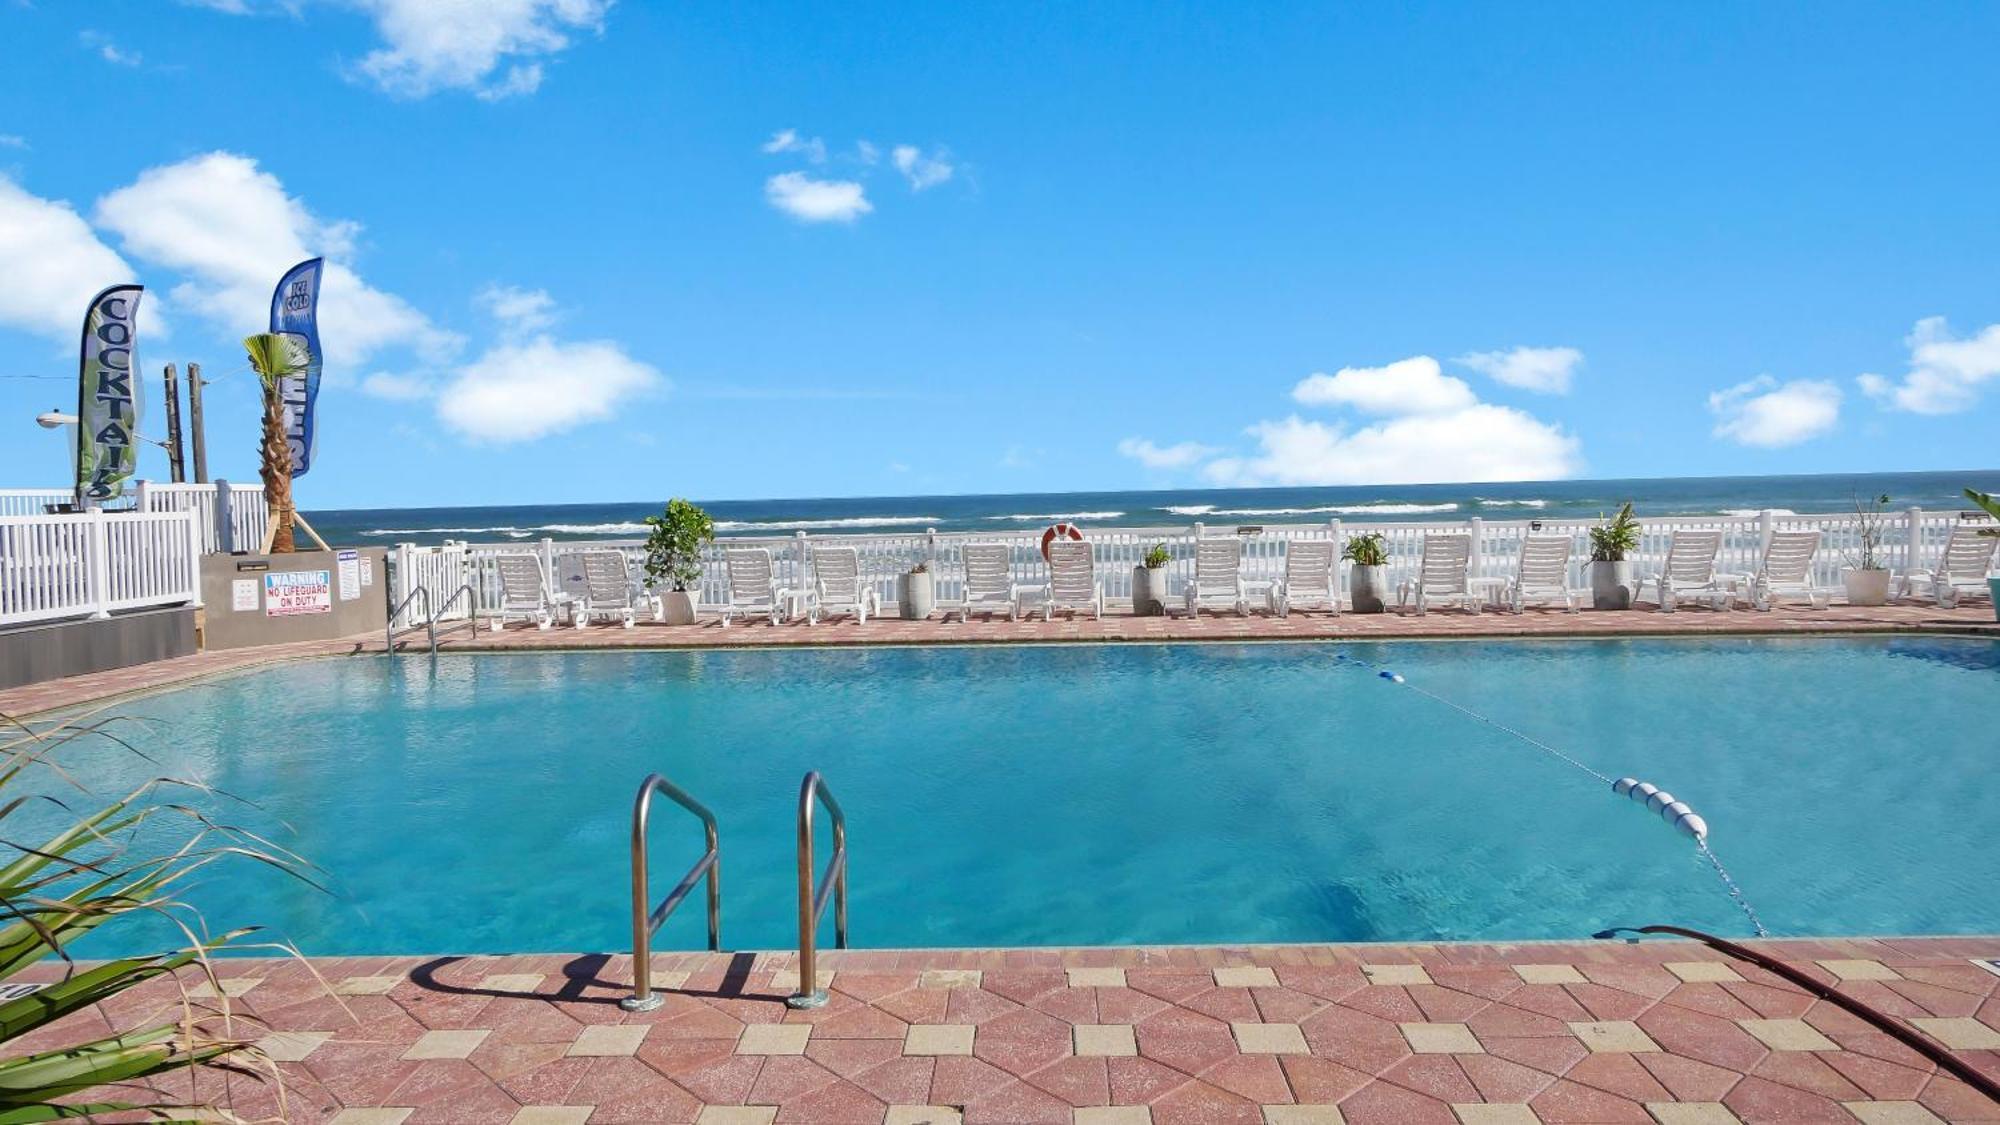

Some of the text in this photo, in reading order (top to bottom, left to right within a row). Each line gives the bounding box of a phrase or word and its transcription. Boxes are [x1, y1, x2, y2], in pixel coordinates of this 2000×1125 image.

[291, 279, 308, 295] ICE
[286, 295, 310, 312] COLD
[272, 571, 325, 586] WARNING
[268, 587, 280, 597] NO
[284, 585, 328, 597] LIFEGUARD
[281, 596, 317, 607] ON DUTY
